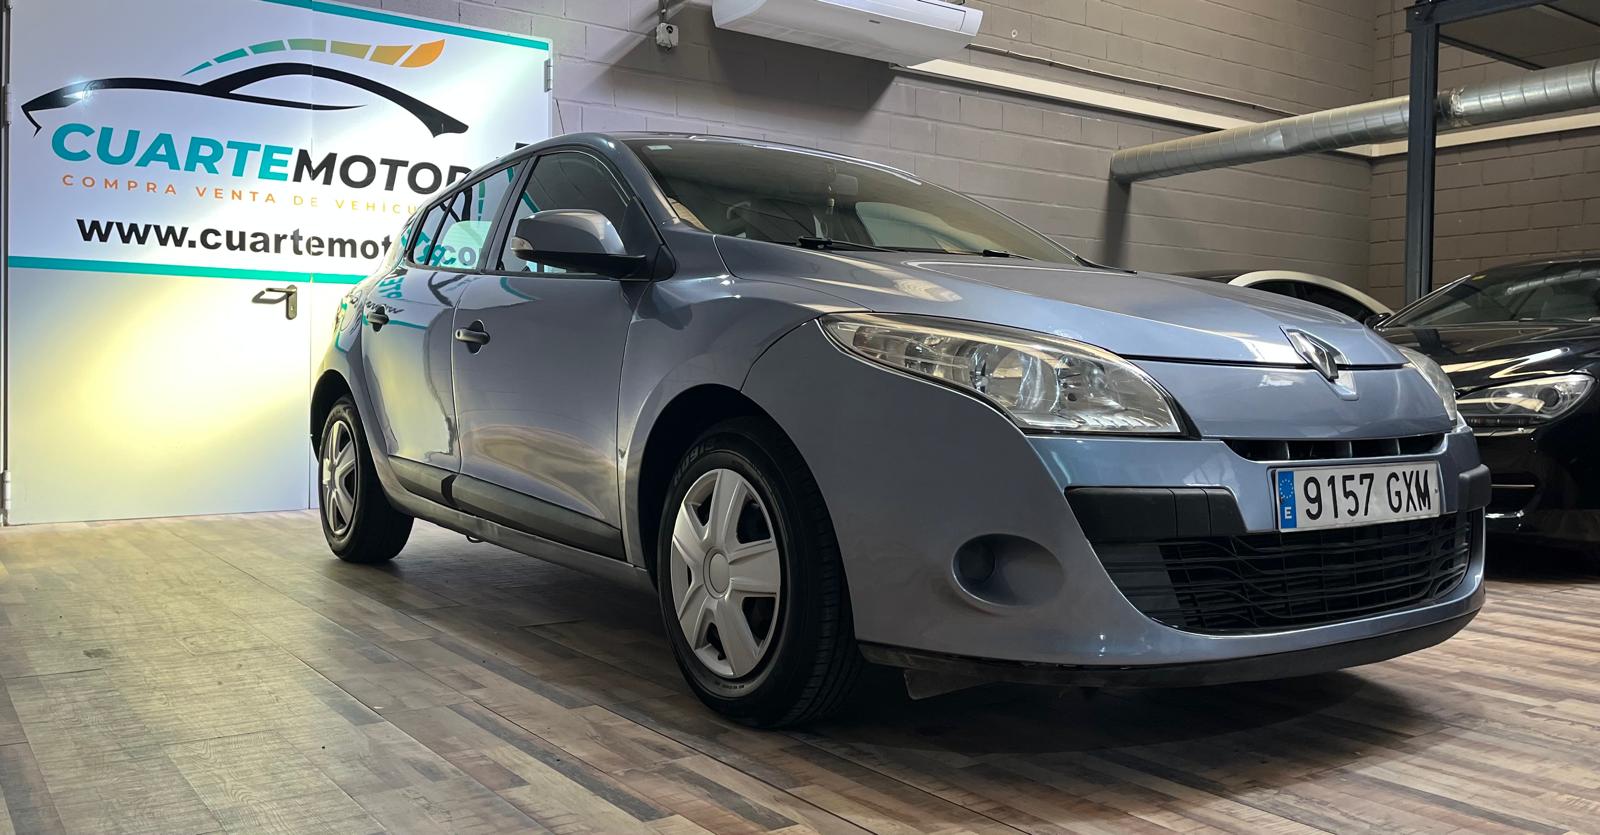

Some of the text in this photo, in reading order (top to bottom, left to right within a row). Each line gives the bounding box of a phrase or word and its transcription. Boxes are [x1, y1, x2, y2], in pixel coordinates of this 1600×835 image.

[62, 174, 417, 216] COMPRA VENTA DE VEHÍCU
[1284, 506, 1292, 519] E
[1303, 469, 1432, 520] 9157 GXM
